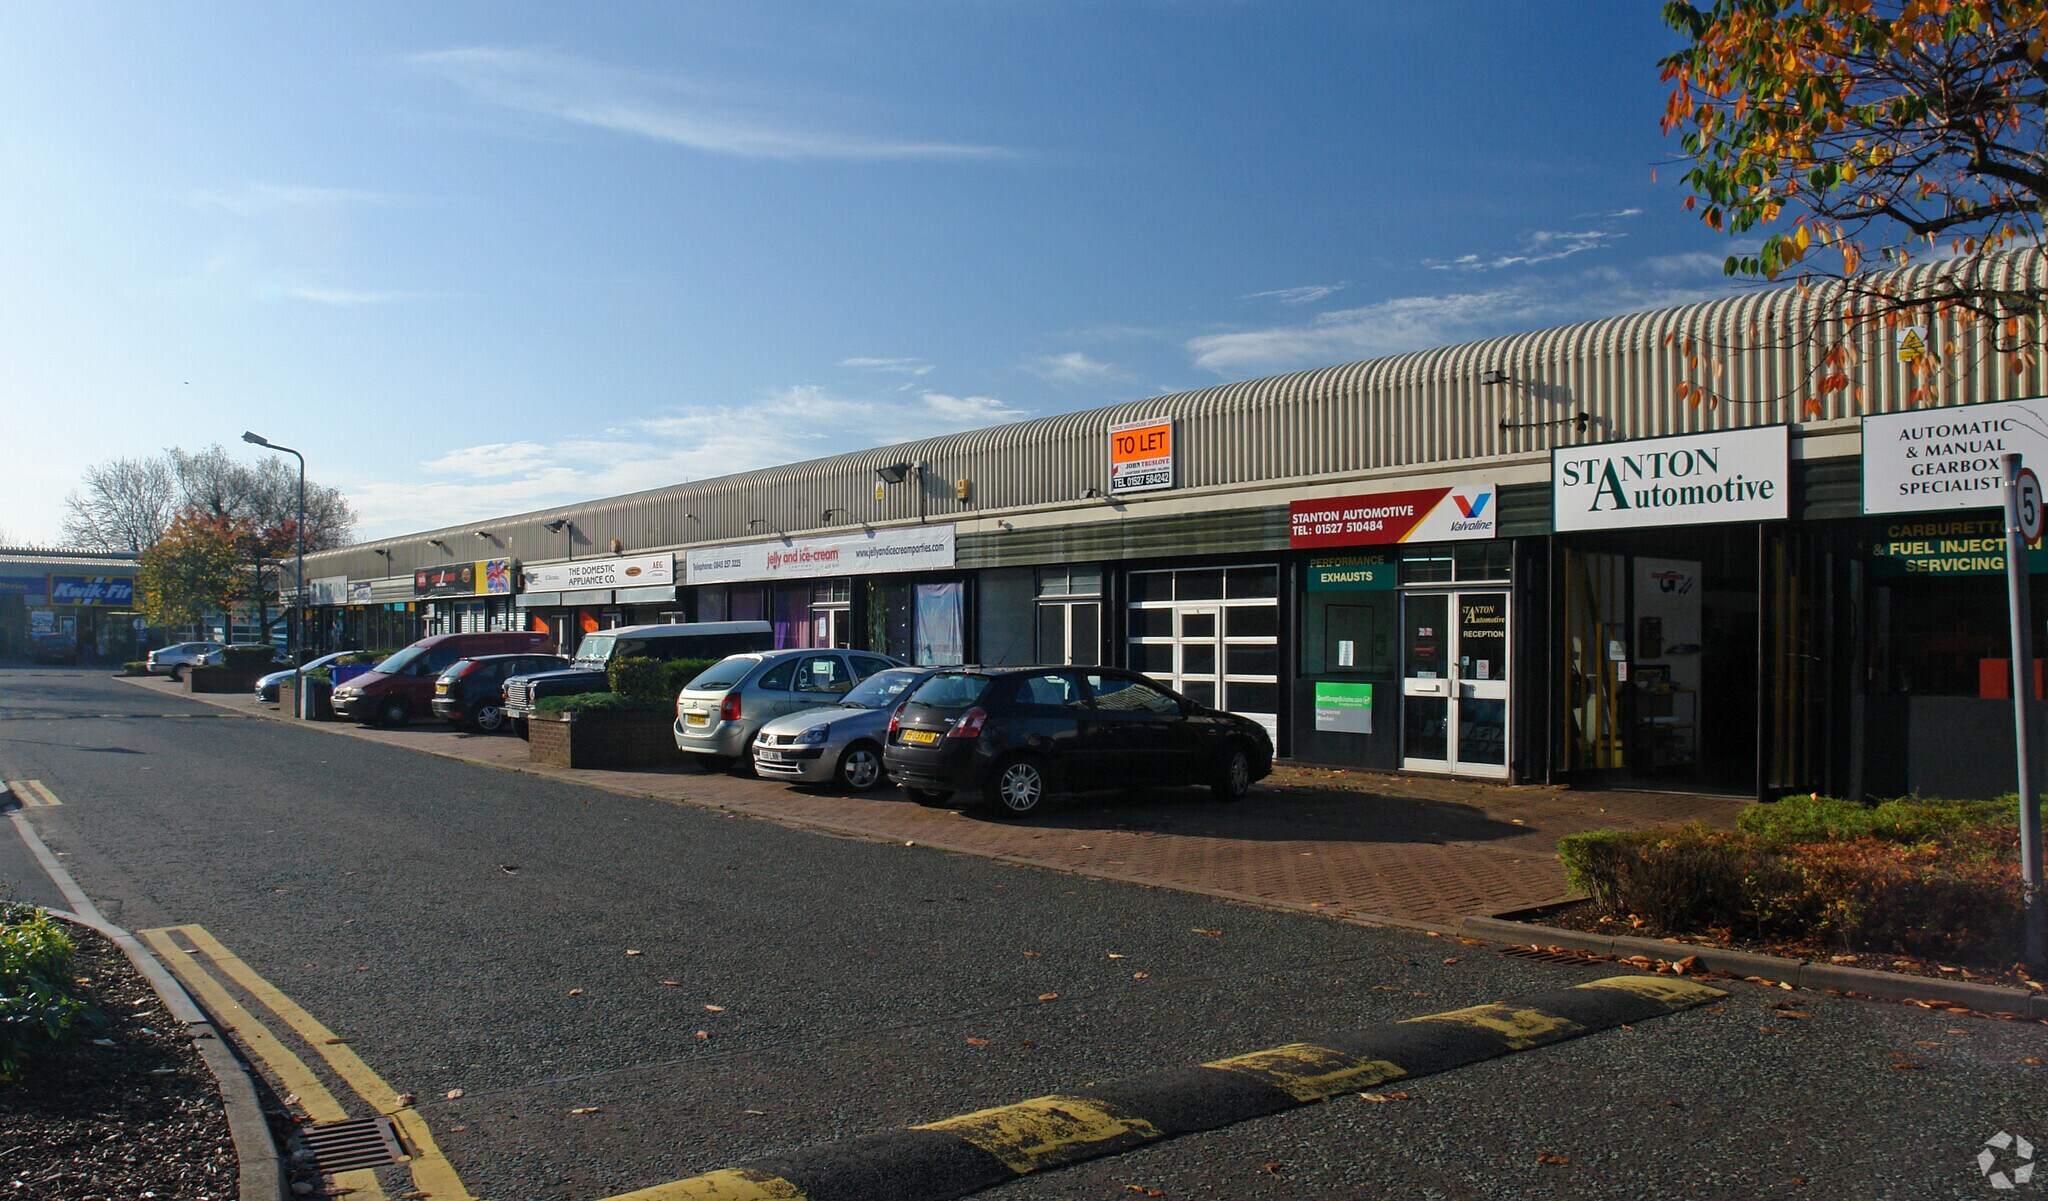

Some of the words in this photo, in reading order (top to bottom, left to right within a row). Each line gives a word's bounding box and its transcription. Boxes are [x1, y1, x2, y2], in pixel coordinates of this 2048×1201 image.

[1898, 418, 2014, 441] AUTOMATIC
[1117, 436, 1135, 455] TO
[1140, 431, 1166, 452] LET
[1906, 446, 1918, 459] &
[1925, 438, 2006, 457] MANUAL
[1562, 447, 1720, 488] STANTON
[1911, 457, 2001, 477] GEARBOX
[1114, 478, 1126, 488] TEL
[1126, 475, 1145, 487] 01527
[1145, 472, 1169, 485] 584242
[1899, 476, 2003, 496] SPECIALIST
[1587, 474, 1774, 511] Automotive
[1292, 510, 1340, 524] STANTON
[1342, 505, 1414, 521] AUTOMOTIVE
[2023, 487, 2034, 527] 5
[1292, 525, 1313, 536] TEL:
[1315, 523, 1342, 535] 01527
[1346, 520, 1383, 533] 510484
[1450, 521, 1493, 532] Valvoline
[1887, 520, 2006, 538] CARBURETT
[855, 543, 945, 559] www.jellyandicecreamparties.com
[1872, 543, 1884, 556] &
[1889, 541, 1935, 556] FUEL
[652, 560, 663, 569] AEG
[766, 552, 782, 571] jelly
[783, 550, 798, 564] and
[799, 549, 839, 562] ice-cream
[1309, 555, 1385, 568] PERFORMANCE
[1905, 556, 2005, 572] SERVICING
[568, 567, 580, 576] THE
[581, 564, 615, 574] DOMESTIC
[1320, 571, 1373, 583] EXHAUSTS
[568, 575, 603, 586] APPLIANCE
[605, 575, 617, 584] CO.
[1462, 605, 1495, 615] STANTON
[1464, 613, 1505, 624] Automotive
[1463, 630, 1504, 638] RECEPTION
